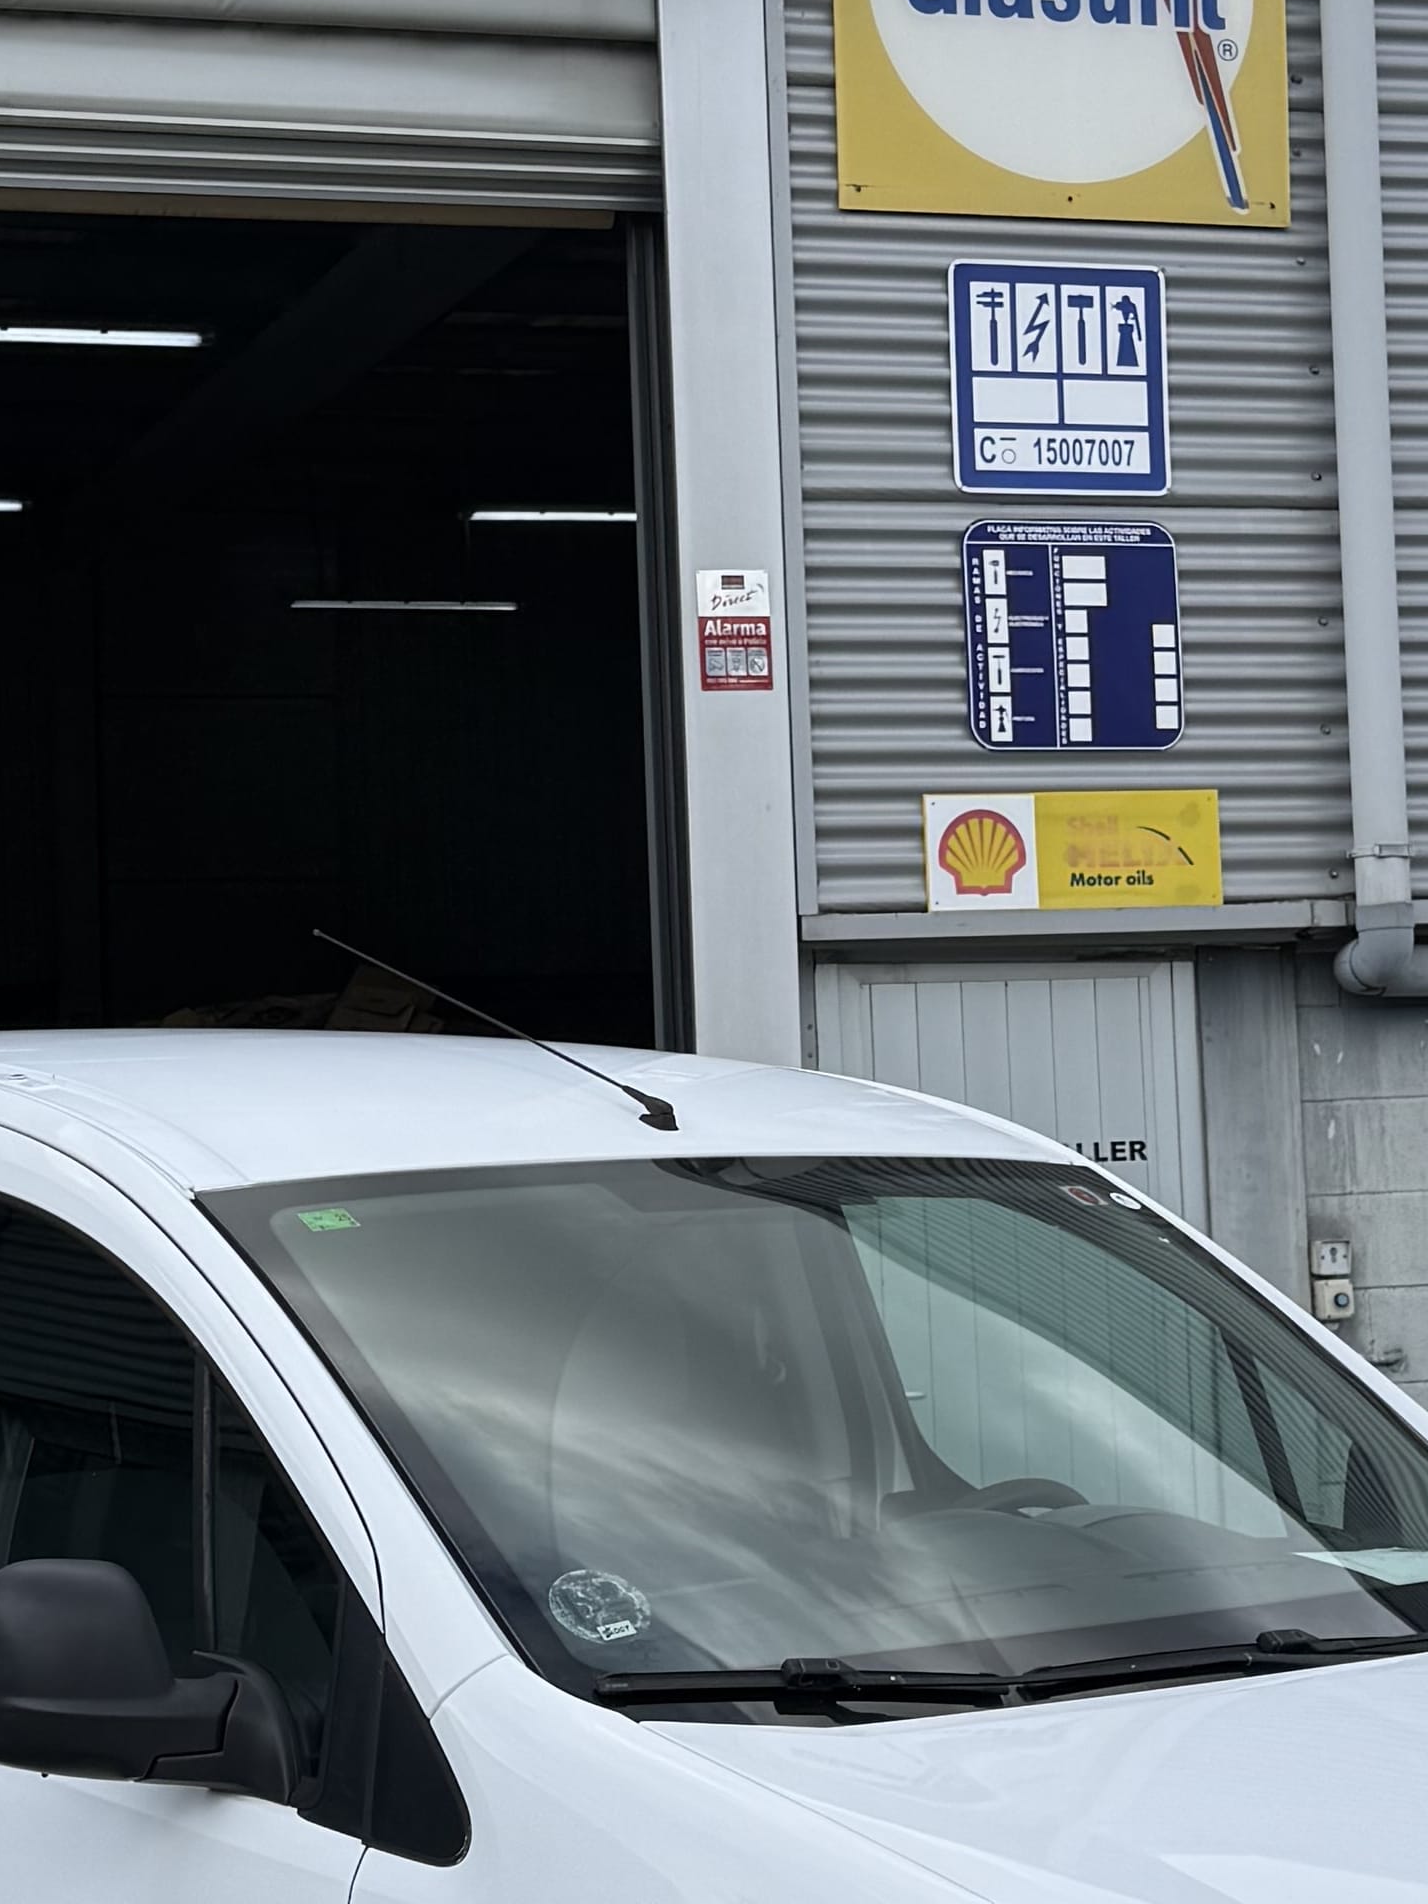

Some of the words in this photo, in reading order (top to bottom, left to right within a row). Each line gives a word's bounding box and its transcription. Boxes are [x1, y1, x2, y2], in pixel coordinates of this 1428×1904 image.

[1033, 437, 1135, 467] 15007007
[972, 557, 981, 604] RAMAS
[704, 619, 767, 637] Alarma
[974, 614, 983, 633] DE
[976, 644, 987, 729] ACTIVIDAD
[1070, 872, 1121, 887] Motor
[1126, 871, 1154, 886] oils
